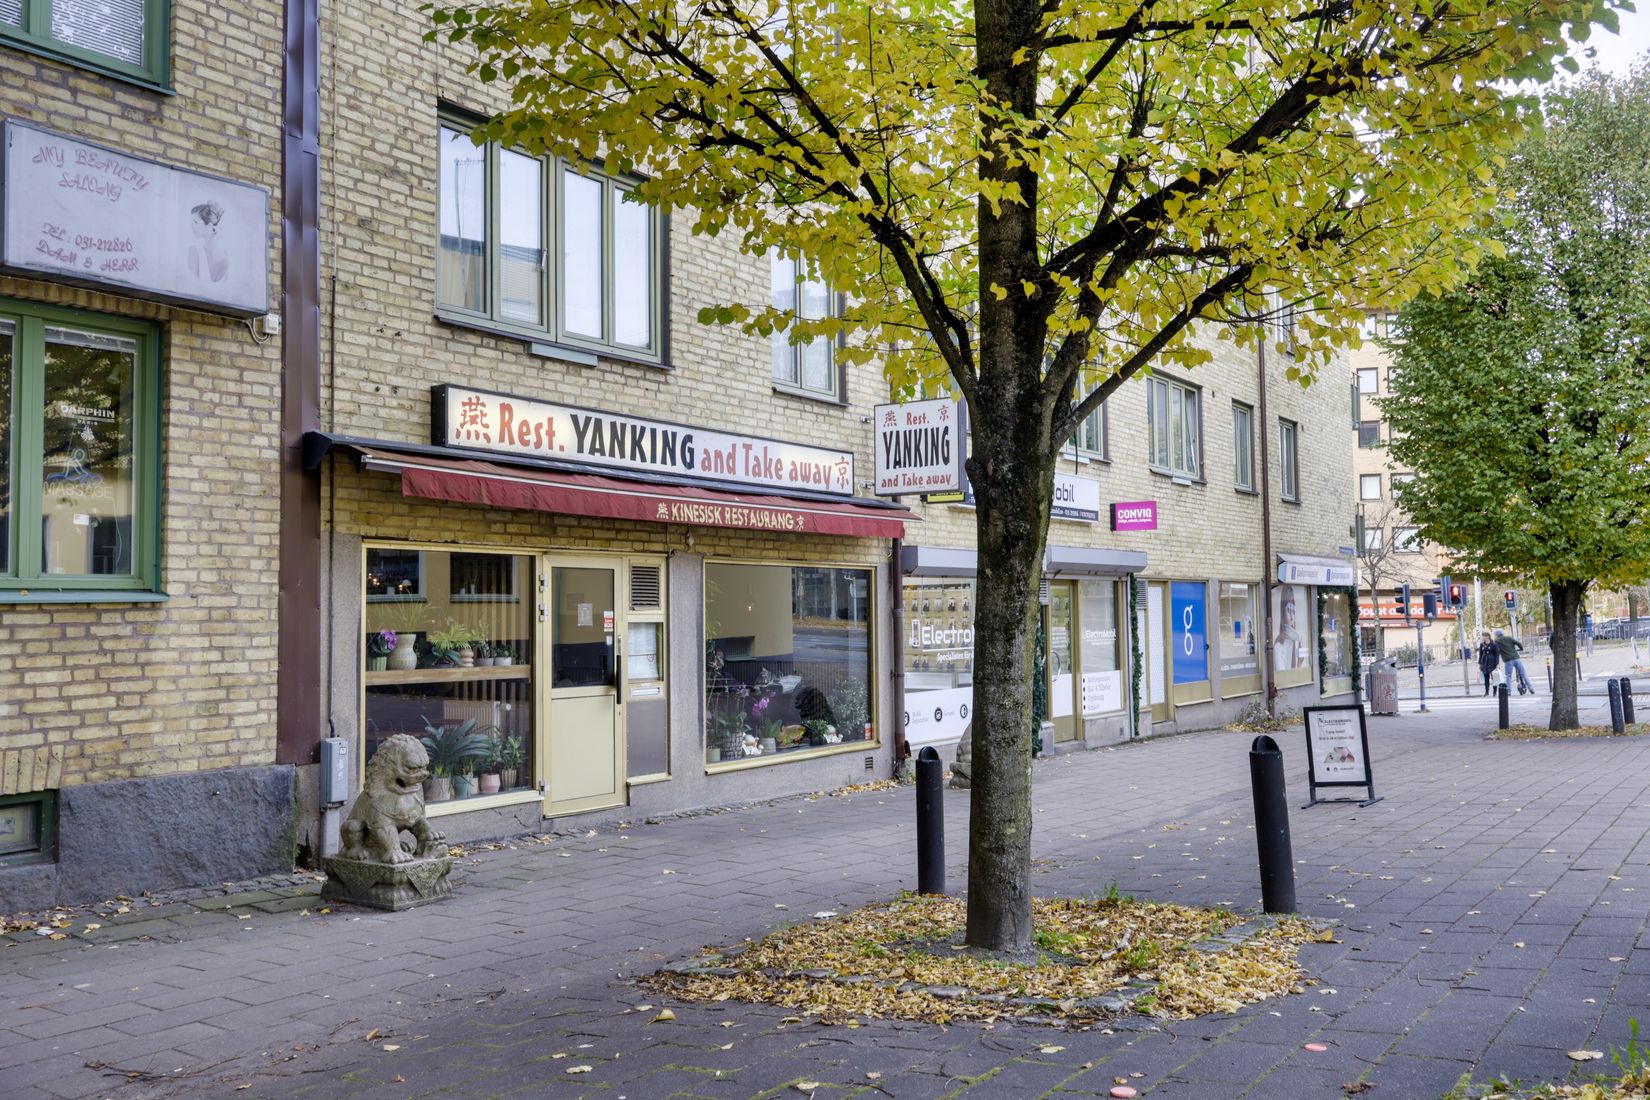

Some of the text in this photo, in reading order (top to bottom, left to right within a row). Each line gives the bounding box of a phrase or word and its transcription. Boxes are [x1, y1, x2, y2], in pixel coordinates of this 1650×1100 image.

[60, 404, 115, 418] DARPHIN
[906, 412, 929, 425] Rest.
[499, 402, 565, 452] Rest.
[570, 413, 695, 470] YANKING
[701, 443, 737, 475] and
[742, 443, 783, 480] Take
[789, 459, 832, 489] away
[883, 425, 950, 470] YANKING
[881, 473, 951, 488] and Take away
[43, 481, 113, 499] MASSAGE
[671, 503, 723, 524] KINESISK
[725, 507, 794, 530] RESTAURANG
[1118, 508, 1152, 519] COMVIQ
